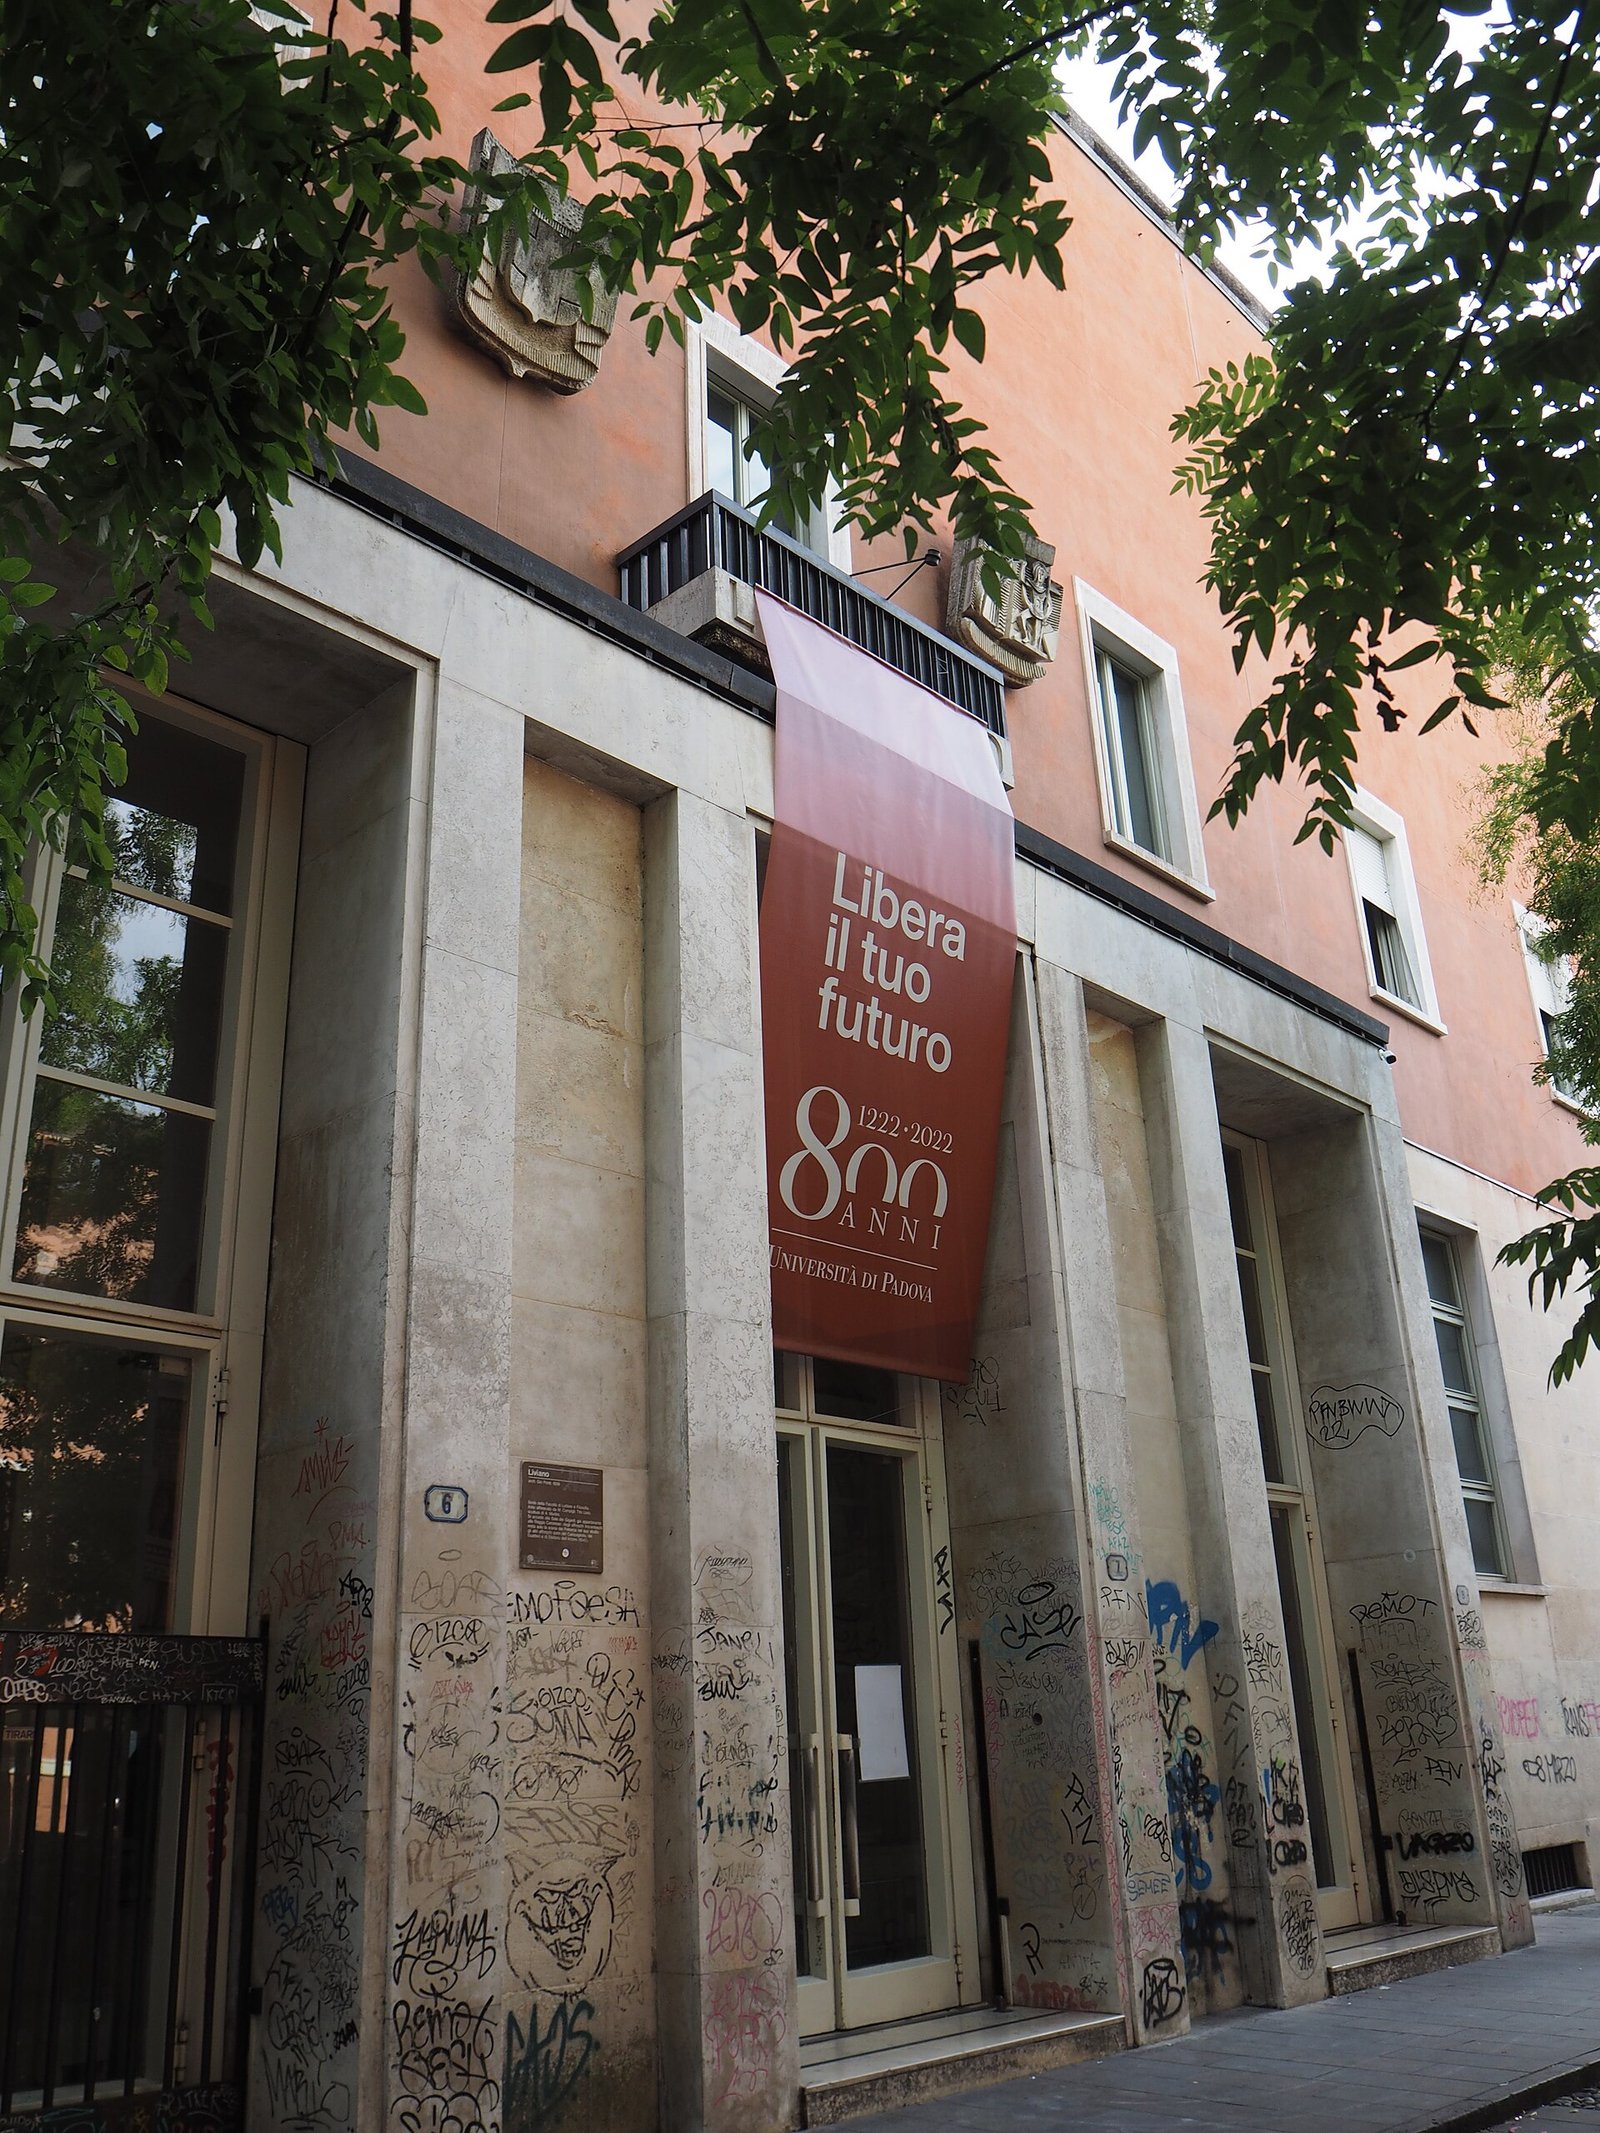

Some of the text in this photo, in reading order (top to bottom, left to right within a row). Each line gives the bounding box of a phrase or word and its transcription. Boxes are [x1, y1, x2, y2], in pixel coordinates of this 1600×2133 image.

[832, 851, 967, 962] Libera
[824, 912, 931, 1004] il tuo
[818, 976, 952, 1073] futuro
[838, 1201, 942, 1250] ANNI
[527, 1468, 550, 1478] Liviano
[441, 1493, 452, 1515] 6
[5, 1729, 34, 1740] TIRAR
